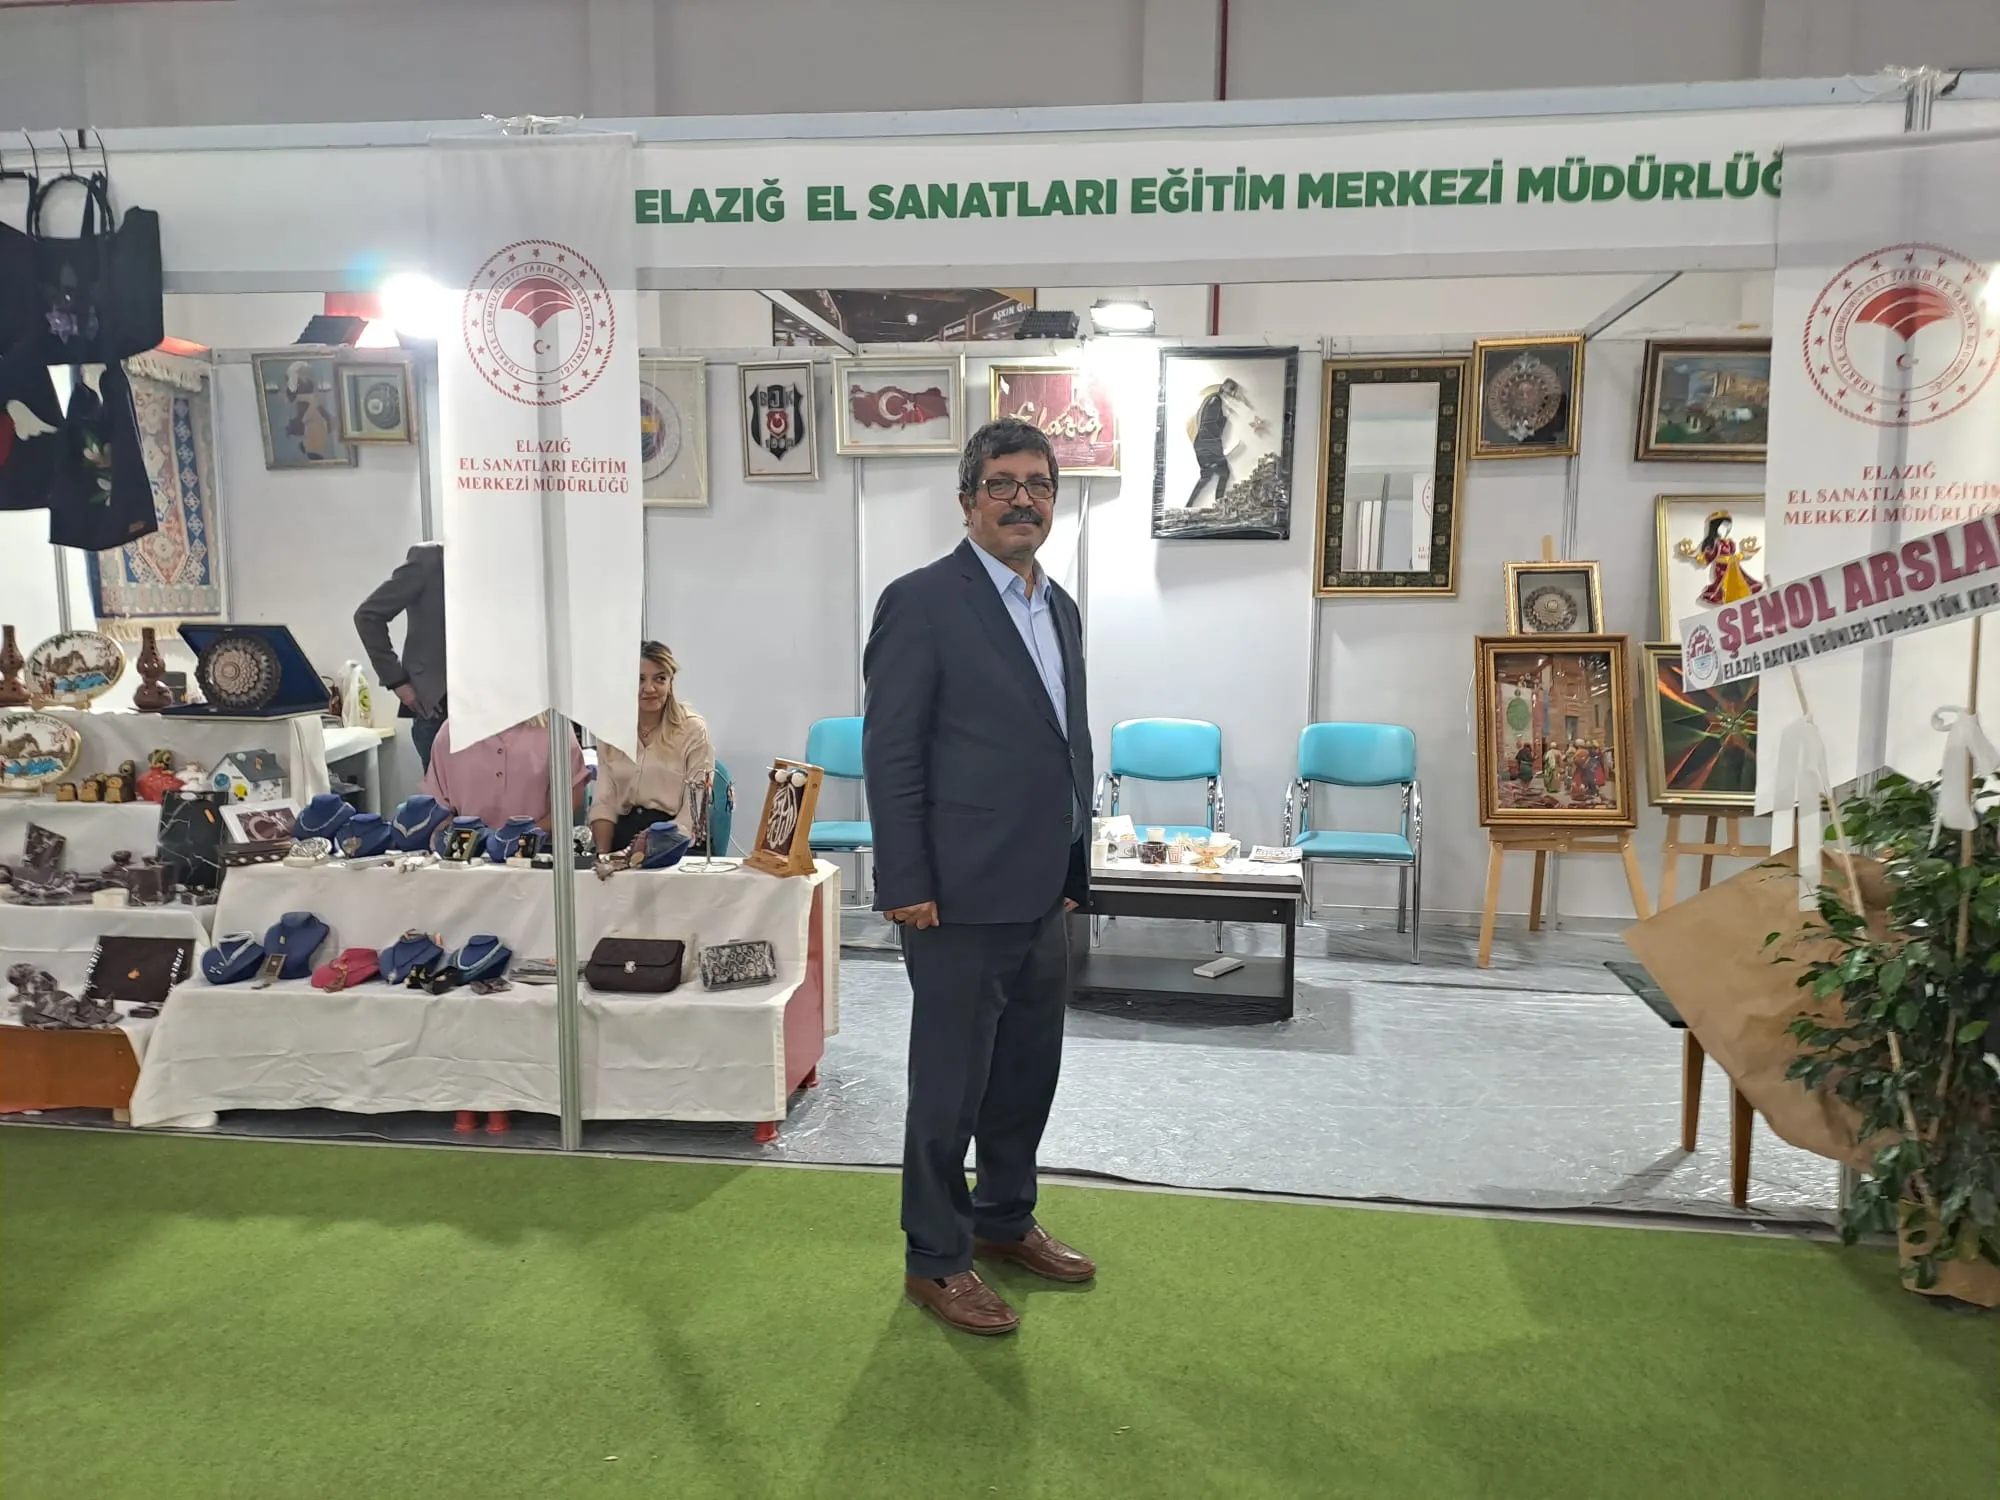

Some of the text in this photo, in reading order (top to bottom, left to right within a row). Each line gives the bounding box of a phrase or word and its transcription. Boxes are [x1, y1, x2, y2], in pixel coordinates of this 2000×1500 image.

[634, 178, 785, 224] ELAZIĞ
[806, 186, 857, 221] EL
[867, 178, 1118, 220] SANATLARI
[1130, 166, 1286, 214] EĞİTİM
[1297, 158, 1503, 210] MERKEZİ
[516, 437, 571, 454] ELAZIĞ
[459, 457, 627, 474] EL SANATLARI EĞİTİM
[1862, 460, 1937, 481] ELAZIĞ
[457, 475, 629, 494] MERKEZİ MÜDÜRLÜĞÜ
[1787, 489, 1812, 504] EL
[1816, 485, 1929, 504] SANATLARI
[1783, 504, 1877, 526] MERKEZİ
[1717, 574, 1837, 659] ŞENOL
[1723, 652, 1762, 680] ELAZIĞ
[1762, 638, 1811, 670] HAYVAN
[1810, 617, 1875, 656] ÜRÜNLERİ
